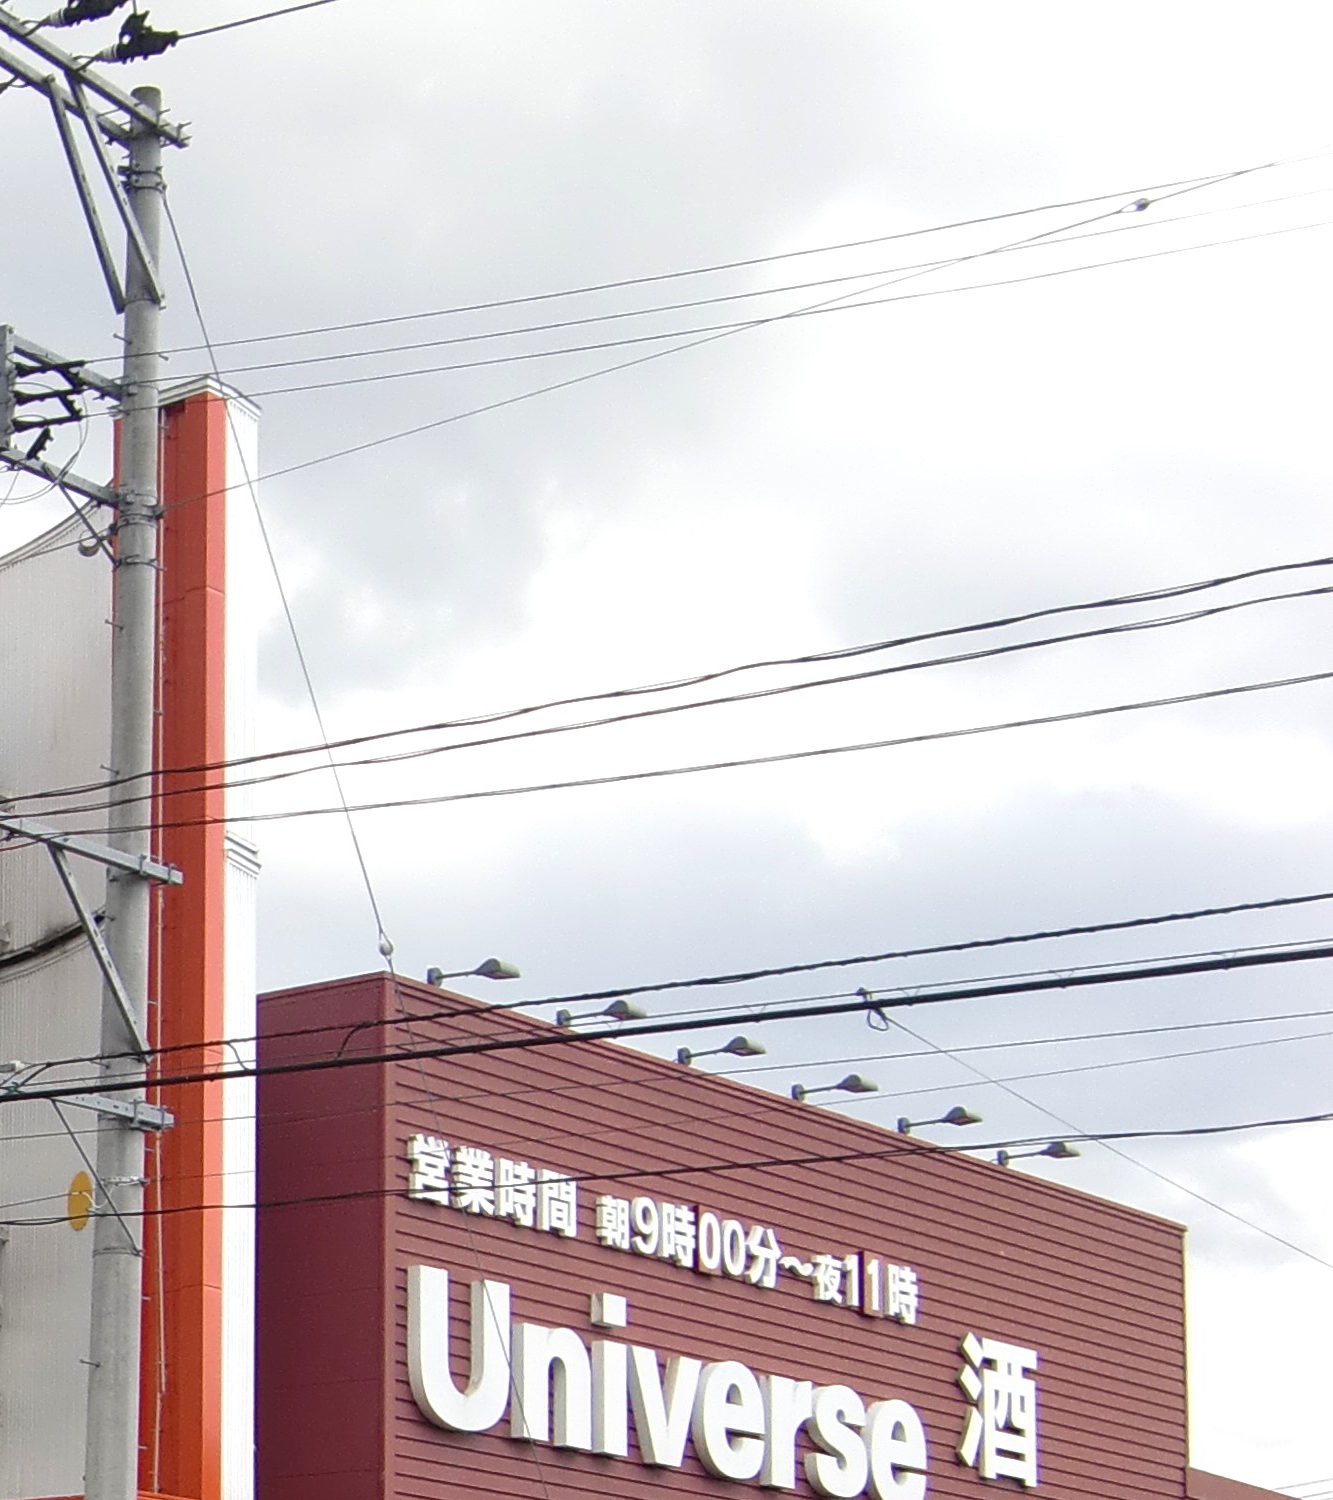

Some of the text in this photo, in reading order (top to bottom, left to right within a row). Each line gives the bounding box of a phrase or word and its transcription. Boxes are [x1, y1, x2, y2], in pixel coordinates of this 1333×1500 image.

[407, 1133, 578, 1238] 営業時間
[955, 1330, 1039, 1489] 酒
